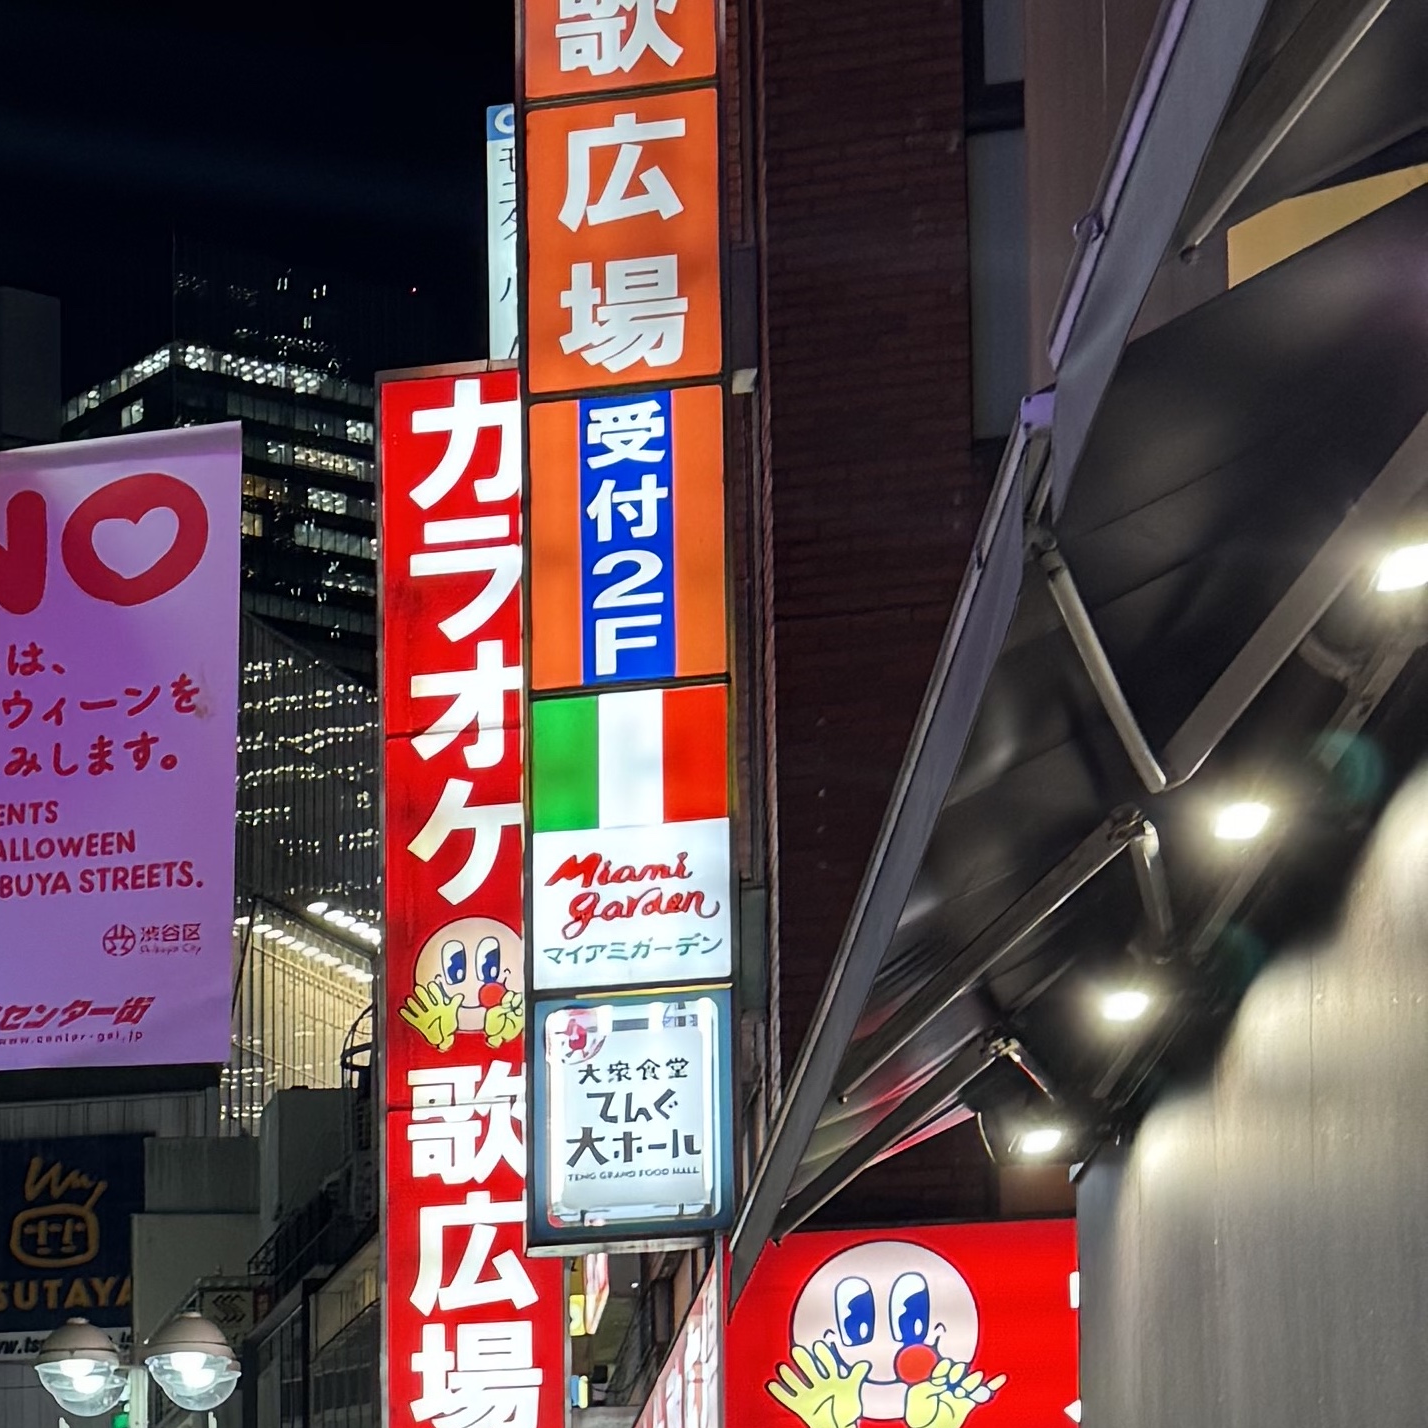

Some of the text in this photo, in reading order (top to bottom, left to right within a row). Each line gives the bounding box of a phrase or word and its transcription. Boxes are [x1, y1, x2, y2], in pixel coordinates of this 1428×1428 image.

[555, 0, 688, 373] 歌広場
[587, 400, 668, 677] 受付2F
[407, 378, 523, 905] カラオケ
[79, 861, 204, 894] STREETS.
[545, 852, 692, 888] Miami
[140, 924, 202, 944] 渋谷区
[543, 934, 723, 964] マイアミガーデン
[578, 1057, 689, 1085] 大衆食堂
[586, 1088, 678, 1123] てんぐ
[566, 1126, 701, 1168] 大ホール
